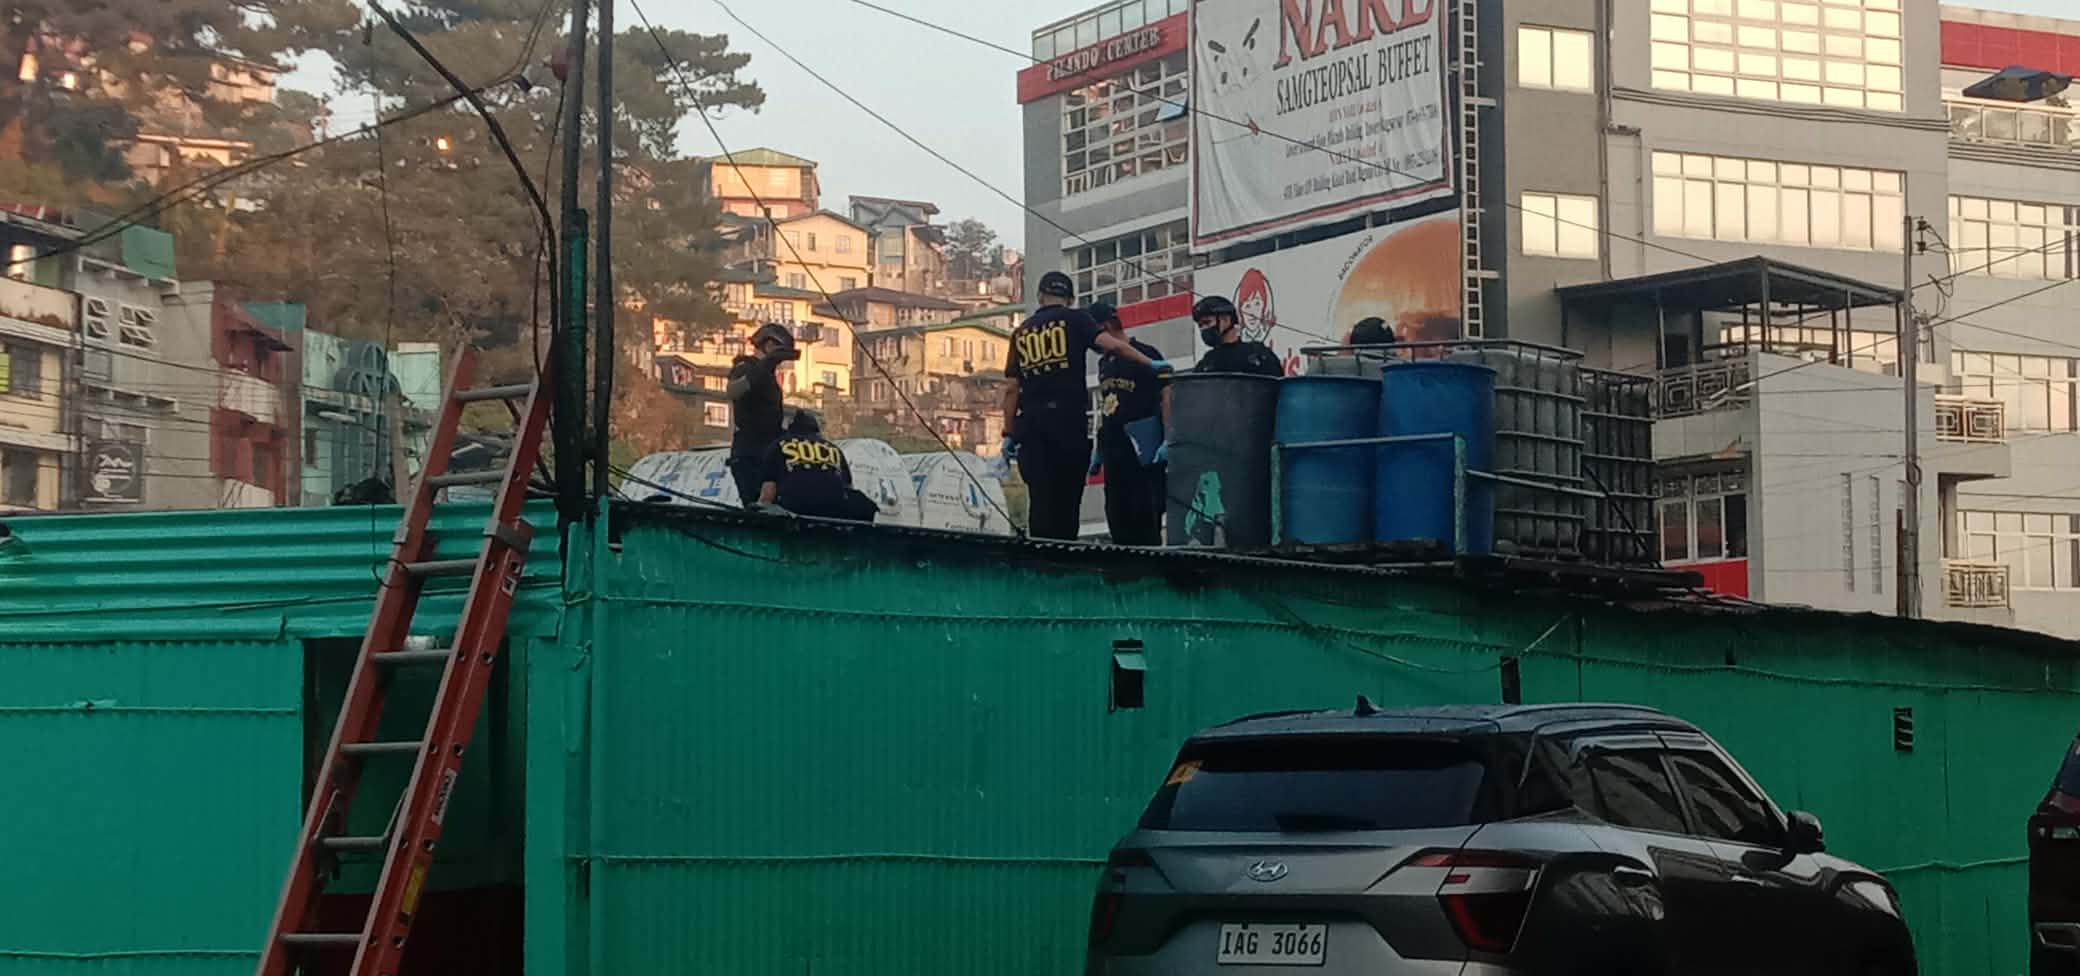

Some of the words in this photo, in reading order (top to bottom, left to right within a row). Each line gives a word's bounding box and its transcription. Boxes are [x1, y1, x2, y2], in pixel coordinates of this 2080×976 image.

[1107, 27, 1160, 61] CENTER
[1276, 53, 1372, 116] SAMGYEOPSAL
[1378, 35, 1432, 87] BUFFET
[1338, 235, 1373, 281] BACONATOR
[1016, 326, 1067, 367] SOCO
[782, 442, 841, 466] SOCO
[1222, 931, 1259, 955] IAG
[1271, 931, 1322, 956] 3066
